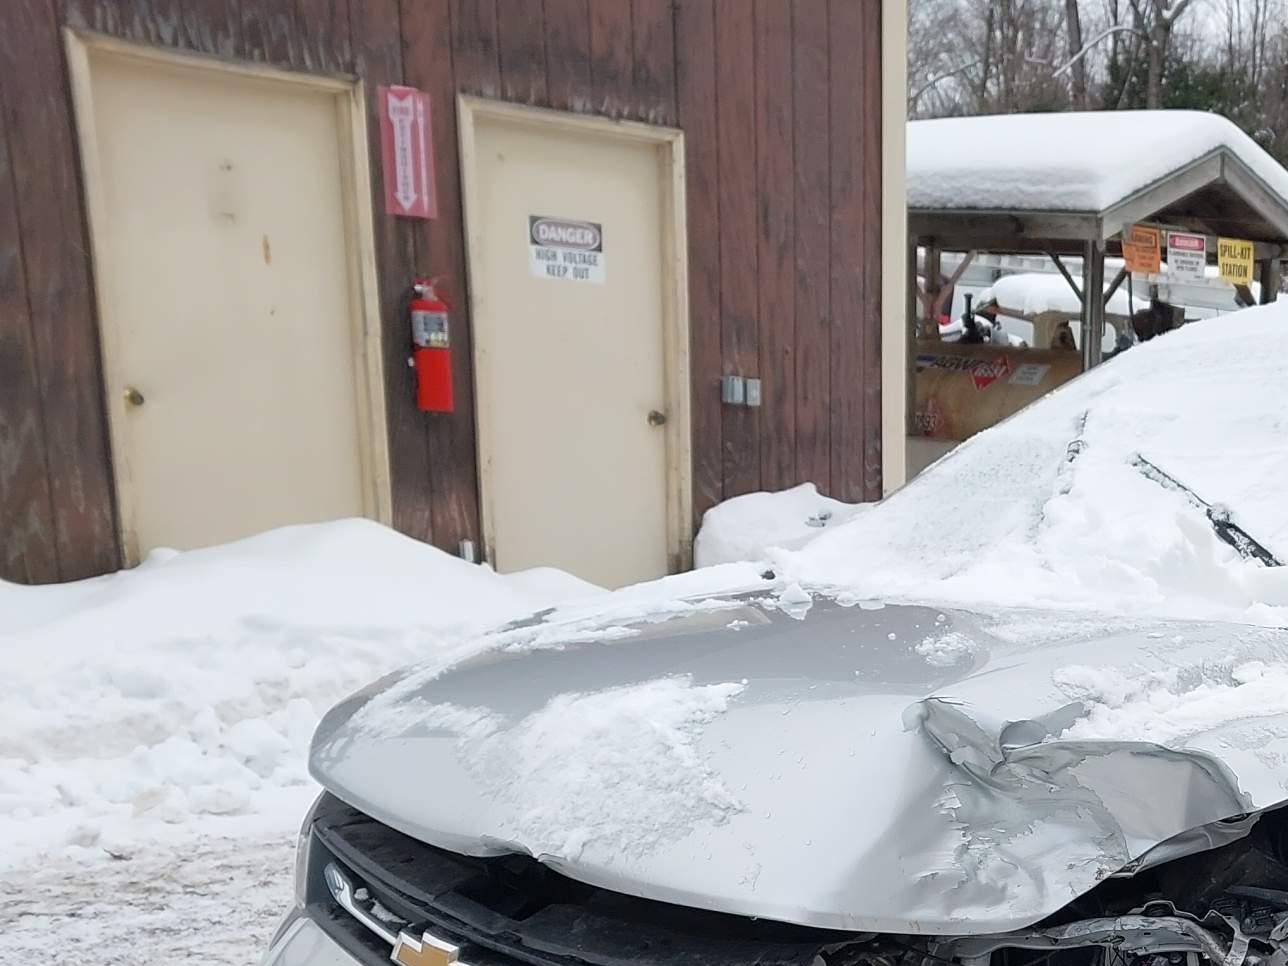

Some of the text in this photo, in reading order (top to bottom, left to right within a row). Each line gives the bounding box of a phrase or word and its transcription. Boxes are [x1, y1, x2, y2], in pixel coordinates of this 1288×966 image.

[539, 223, 594, 246] DANGER
[535, 248, 599, 267] HIGH VOLTAGE
[1220, 244, 1251, 260] SPILL-KIT
[546, 264, 590, 280] KEEP OUT
[1221, 262, 1248, 278] STATION
